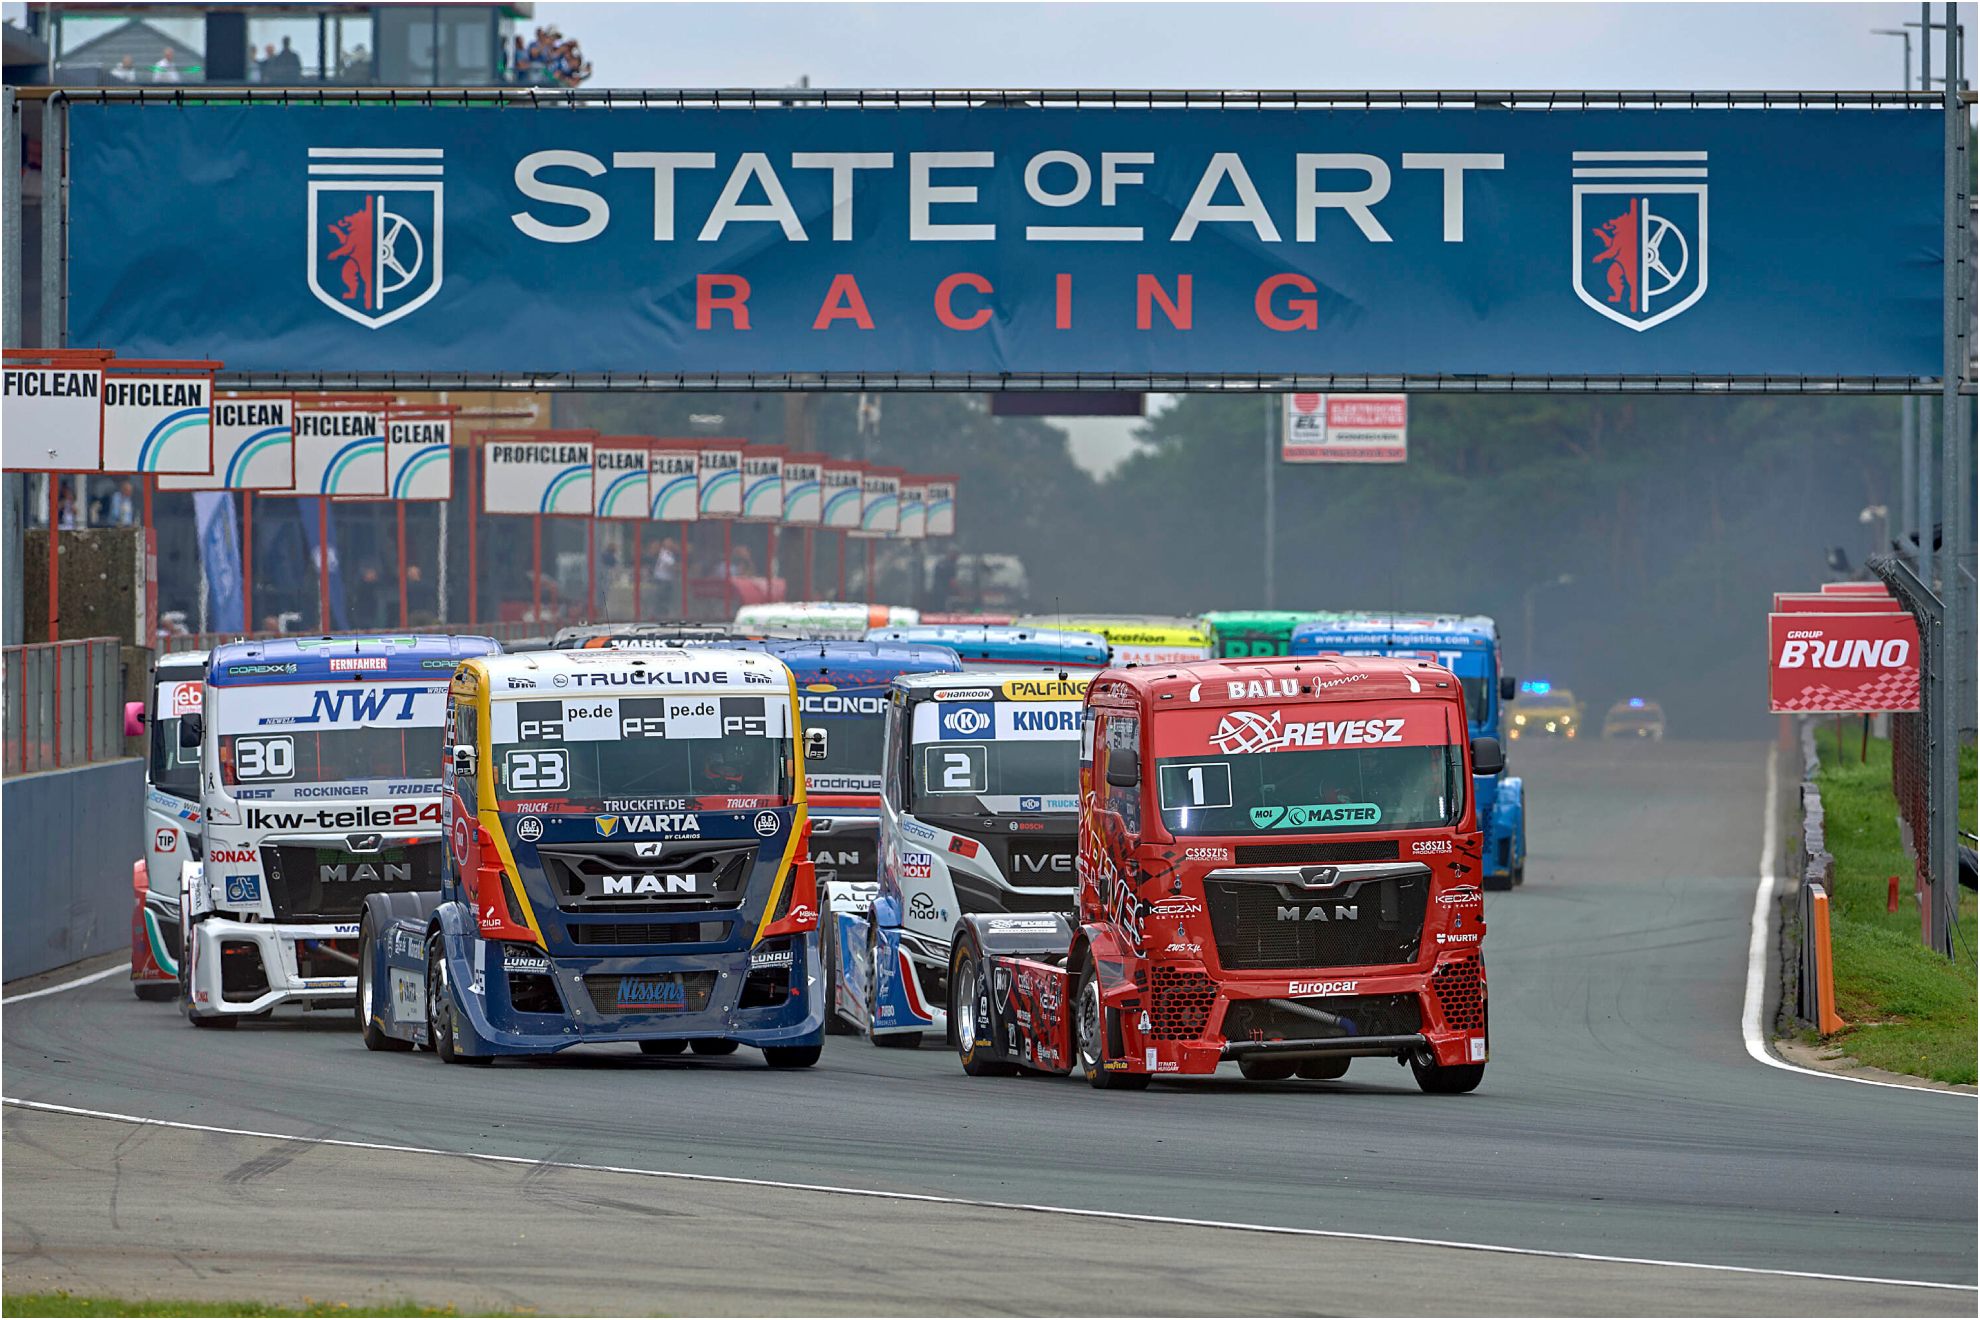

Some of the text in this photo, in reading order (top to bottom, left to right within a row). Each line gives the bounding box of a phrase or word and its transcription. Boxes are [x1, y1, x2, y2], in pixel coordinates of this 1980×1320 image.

[511, 150, 1504, 243] STATE OF ART
[696, 273, 1319, 331] RACING
[104, 383, 201, 406] OFICLEAN
[216, 405, 283, 426] ICLEAN
[493, 446, 588, 463] PROFICLEAN
[598, 453, 643, 469] CLEAN
[1315, 635, 1469, 645] www.reinert-logistics.com
[1779, 640, 1909, 668] BRUNO
[229, 666, 284, 674] COREXX
[331, 659, 387, 670] FERNFAHRER
[571, 671, 728, 686] TRUCKLINE
[1312, 673, 1368, 698] Junior
[1227, 679, 1299, 699] BALU
[311, 688, 416, 722] NWT
[670, 702, 715, 719] pe.de
[568, 705, 613, 722] pe.de
[521, 720, 563, 740] PE
[622, 716, 665, 738] PE
[724, 716, 765, 736] PE
[238, 740, 293, 776] 30
[512, 754, 564, 789] 23
[944, 754, 970, 787] 2
[294, 786, 369, 797] ROCKINGER
[388, 784, 442, 794] TRIDEC
[1187, 767, 1205, 804] 1
[234, 789, 275, 799] JOST
[603, 799, 686, 812] TRUCKFIT.DE
[247, 804, 442, 829] lkw-teile24
[1255, 810, 1273, 818] MOL
[1308, 808, 1376, 821] MASTER
[622, 814, 701, 833] VARTA
[158, 836, 174, 846] TIP
[210, 850, 257, 862] SONAX
[806, 851, 859, 865] AN
[903, 853, 930, 864] LIQUI
[320, 864, 411, 882] MAN
[903, 866, 931, 877] MOLY
[603, 874, 697, 894] MAN
[909, 907, 939, 919] hadi
[1277, 906, 1358, 921] MAN
[482, 919, 501, 927] ZIUR
[1447, 934, 1478, 942] WÜRTH
[503, 958, 545, 967] LUNAU
[752, 951, 791, 963] LUNAU
[618, 977, 684, 1001] Nissens
[1288, 981, 1359, 997] Europcar
